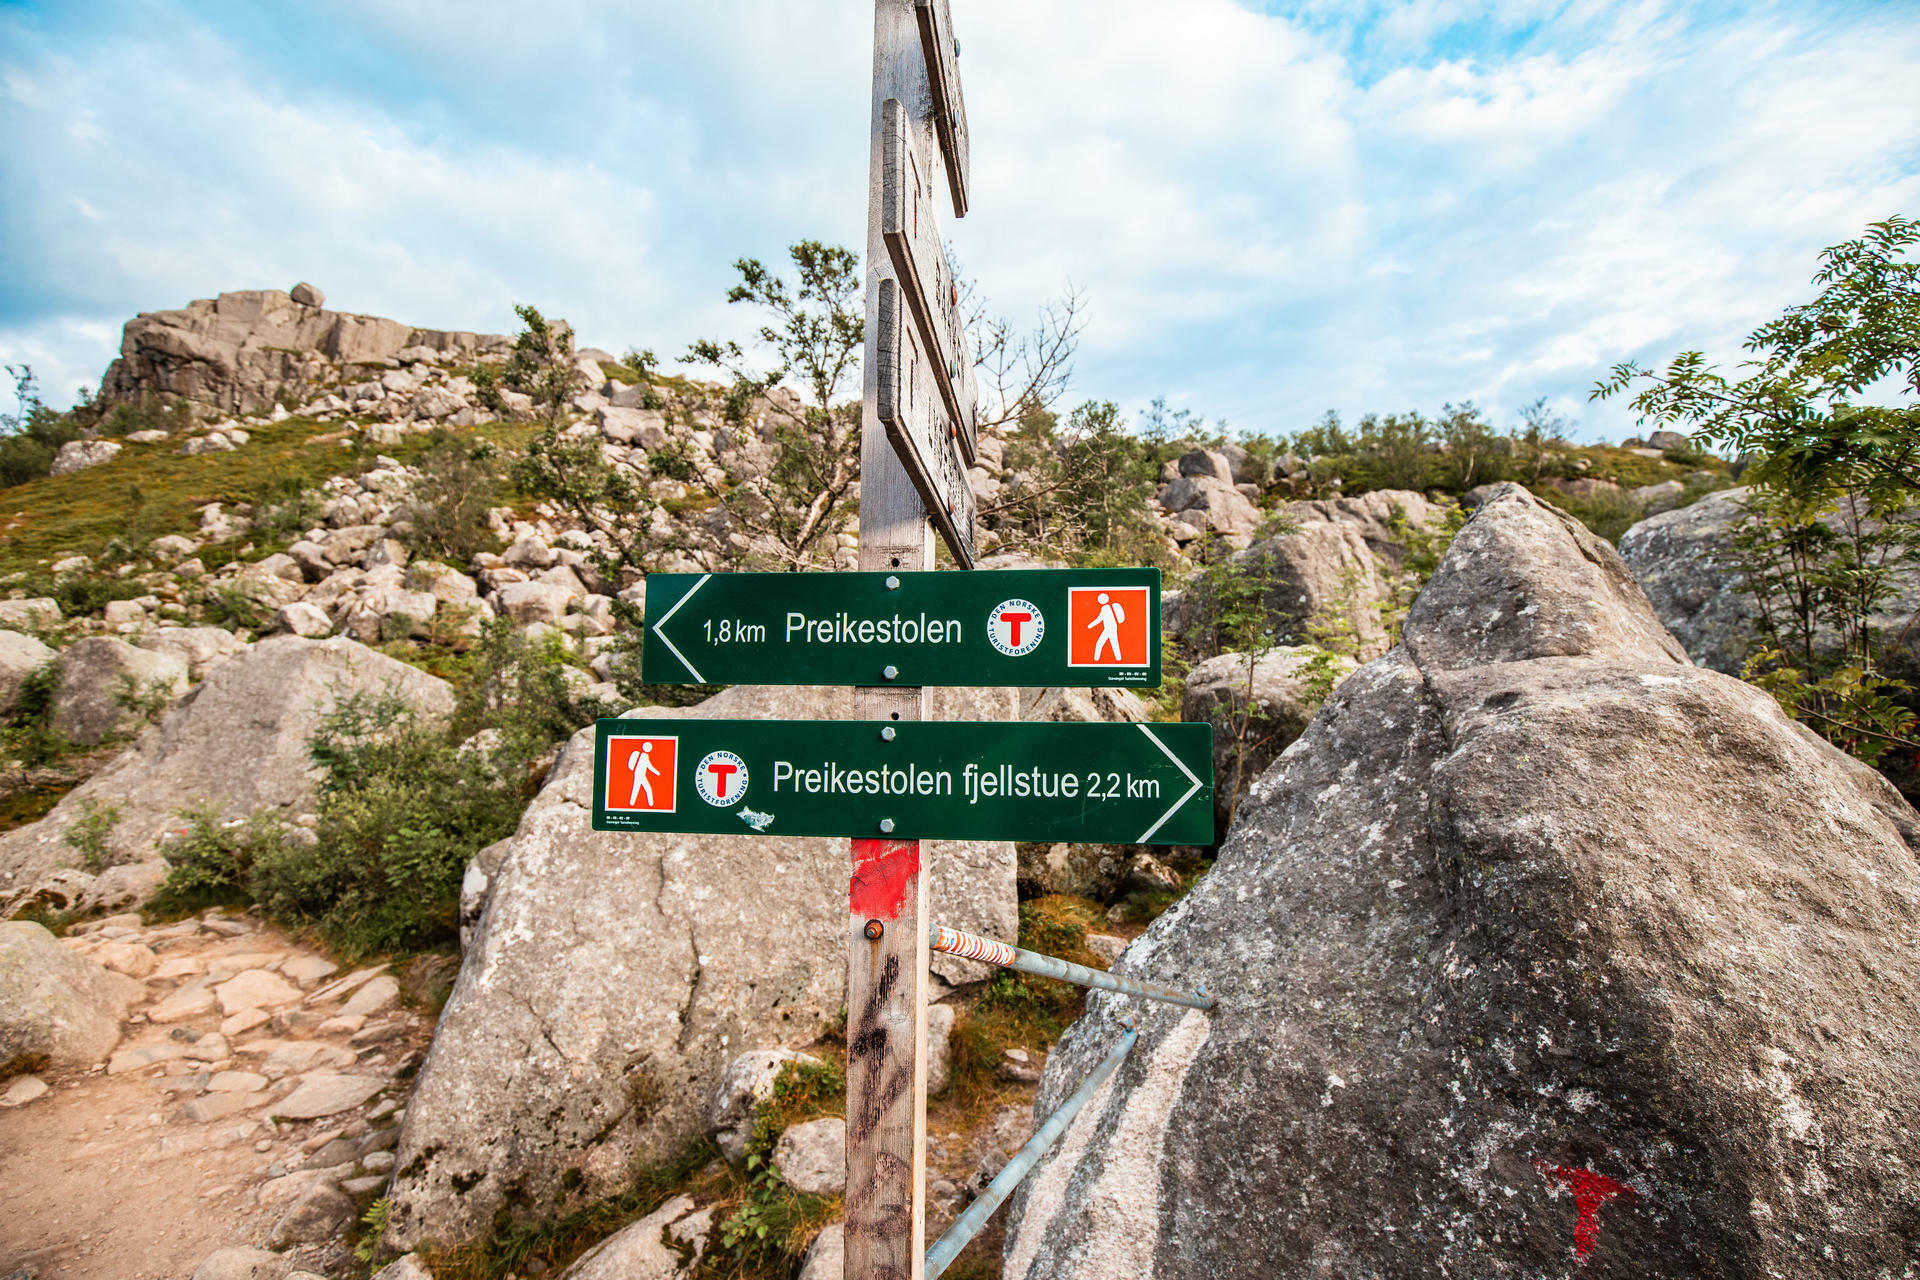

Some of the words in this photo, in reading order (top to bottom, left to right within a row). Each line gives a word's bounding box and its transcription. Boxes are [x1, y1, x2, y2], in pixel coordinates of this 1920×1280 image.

[991, 603, 1006, 619] DEN
[1009, 600, 1041, 619] NORSKE
[703, 619, 732, 646] 1,8
[735, 619, 766, 643] km
[786, 612, 962, 644] Preikestolen
[989, 627, 1044, 655] TURISTFORENING
[1000, 612, 1032, 647] T
[700, 755, 714, 770] DEN
[717, 752, 746, 771] NORSKE
[697, 778, 748, 806] TURISTFORENING
[708, 763, 738, 798] T
[773, 761, 952, 796] Preikestolen
[962, 761, 1079, 805] fjellstue
[1086, 772, 1121, 802] 2,2
[1127, 772, 1160, 799] km
